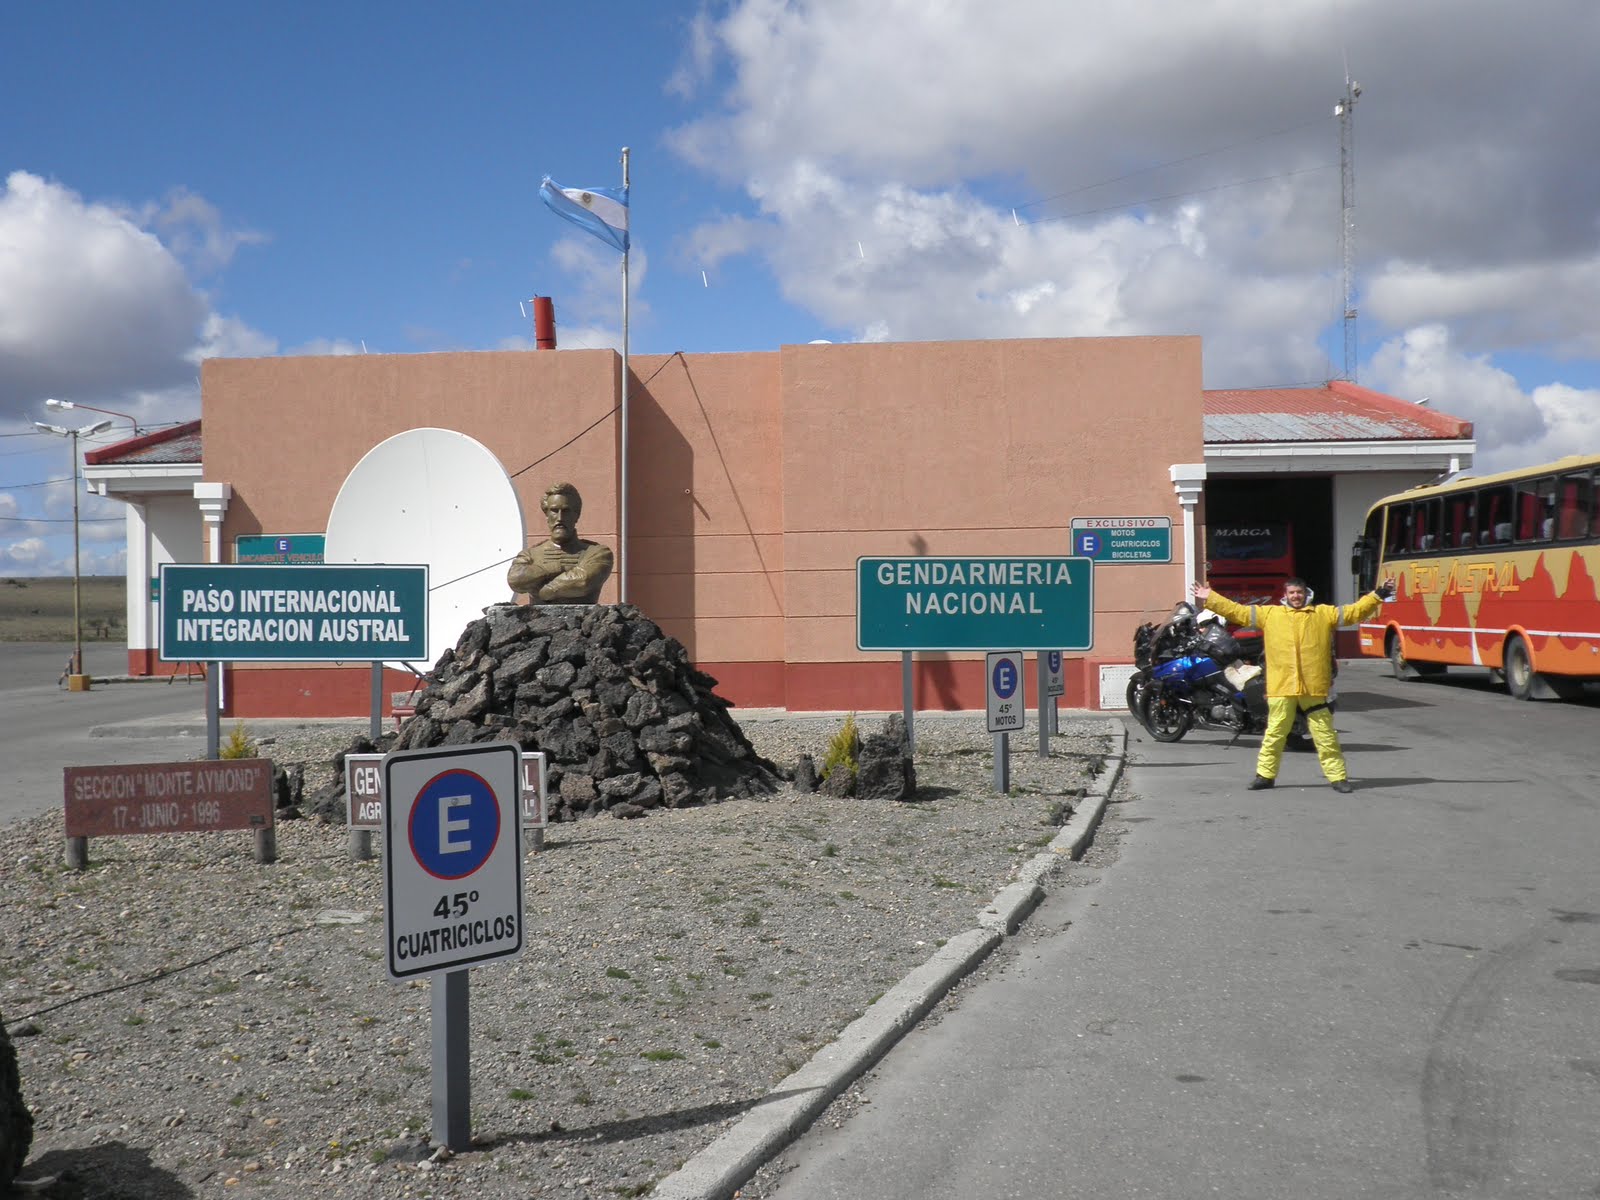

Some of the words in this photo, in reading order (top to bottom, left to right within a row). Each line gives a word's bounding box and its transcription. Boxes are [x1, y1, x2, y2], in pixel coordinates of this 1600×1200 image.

[1086, 519, 1155, 528] EXCLUSIVO
[1110, 529, 1136, 537] MOTOS
[1215, 528, 1272, 537] MARGA
[279, 540, 287, 550] E
[1083, 536, 1094, 551] E
[1110, 540, 1161, 548] CUATRICICLOS
[1111, 551, 1152, 559] BICICLETAS
[876, 562, 1072, 585] GENDARMERIA
[1445, 559, 1520, 596] AUSTRAL
[182, 589, 234, 613] PASO
[240, 589, 401, 613] INTERNACIONAL
[905, 591, 1043, 614] NACIONAL
[176, 618, 313, 642] INTEGRACION
[318, 618, 410, 642] AUSTRAL
[1000, 667, 1010, 690] E
[995, 715, 1017, 726] MOTOS
[74, 775, 136, 801] SECCION
[112, 805, 128, 828] 17
[139, 803, 180, 828] JUNIO
[191, 801, 221, 825] 1996
[438, 794, 472, 855] E
[397, 914, 516, 961] CUATRICICLOS
